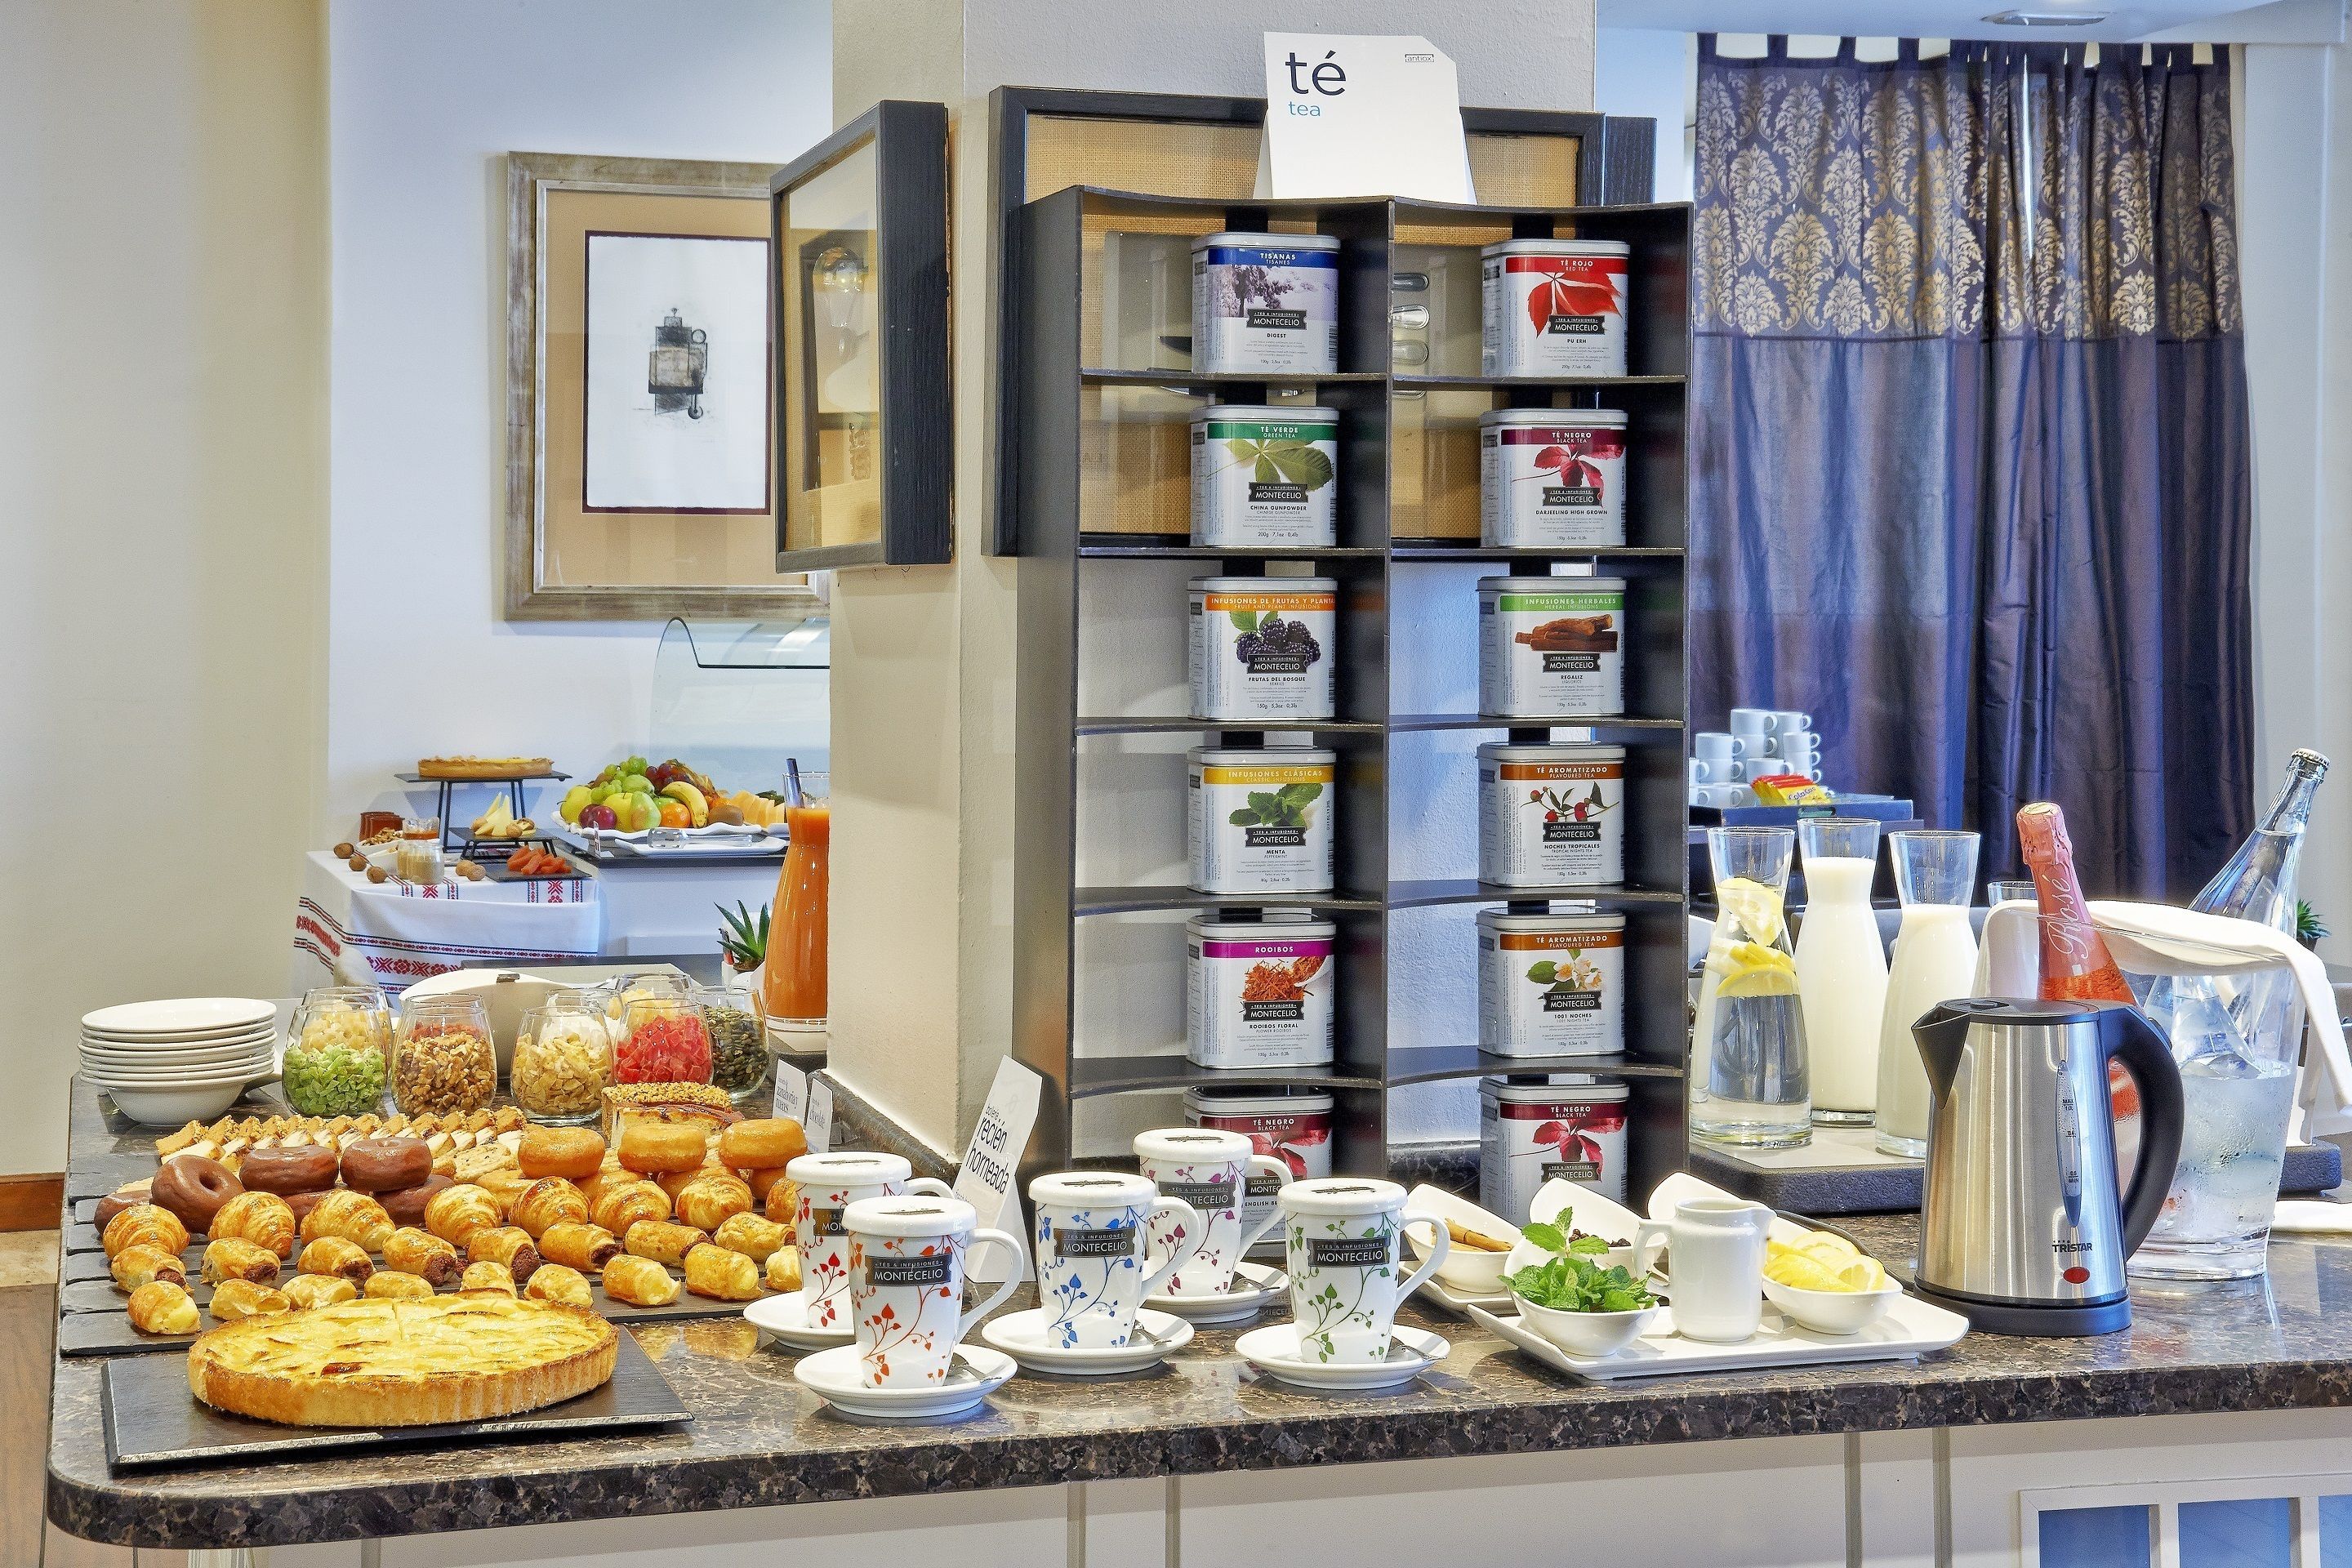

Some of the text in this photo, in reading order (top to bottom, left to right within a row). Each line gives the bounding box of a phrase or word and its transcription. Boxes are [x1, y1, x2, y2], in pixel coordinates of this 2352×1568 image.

[1285, 51, 1347, 96] té
[1289, 101, 1321, 116] tea
[2048, 874, 2089, 960] Rosé
[977, 1117, 1008, 1153] recién
[965, 1139, 1009, 1196] horneada
[1062, 1241, 1127, 1252] MONTECELIO
[2052, 1240, 2093, 1253] TRISTAR
[1317, 1250, 1383, 1262] MONTECELIO
[875, 1269, 942, 1281] MONTECELIO
